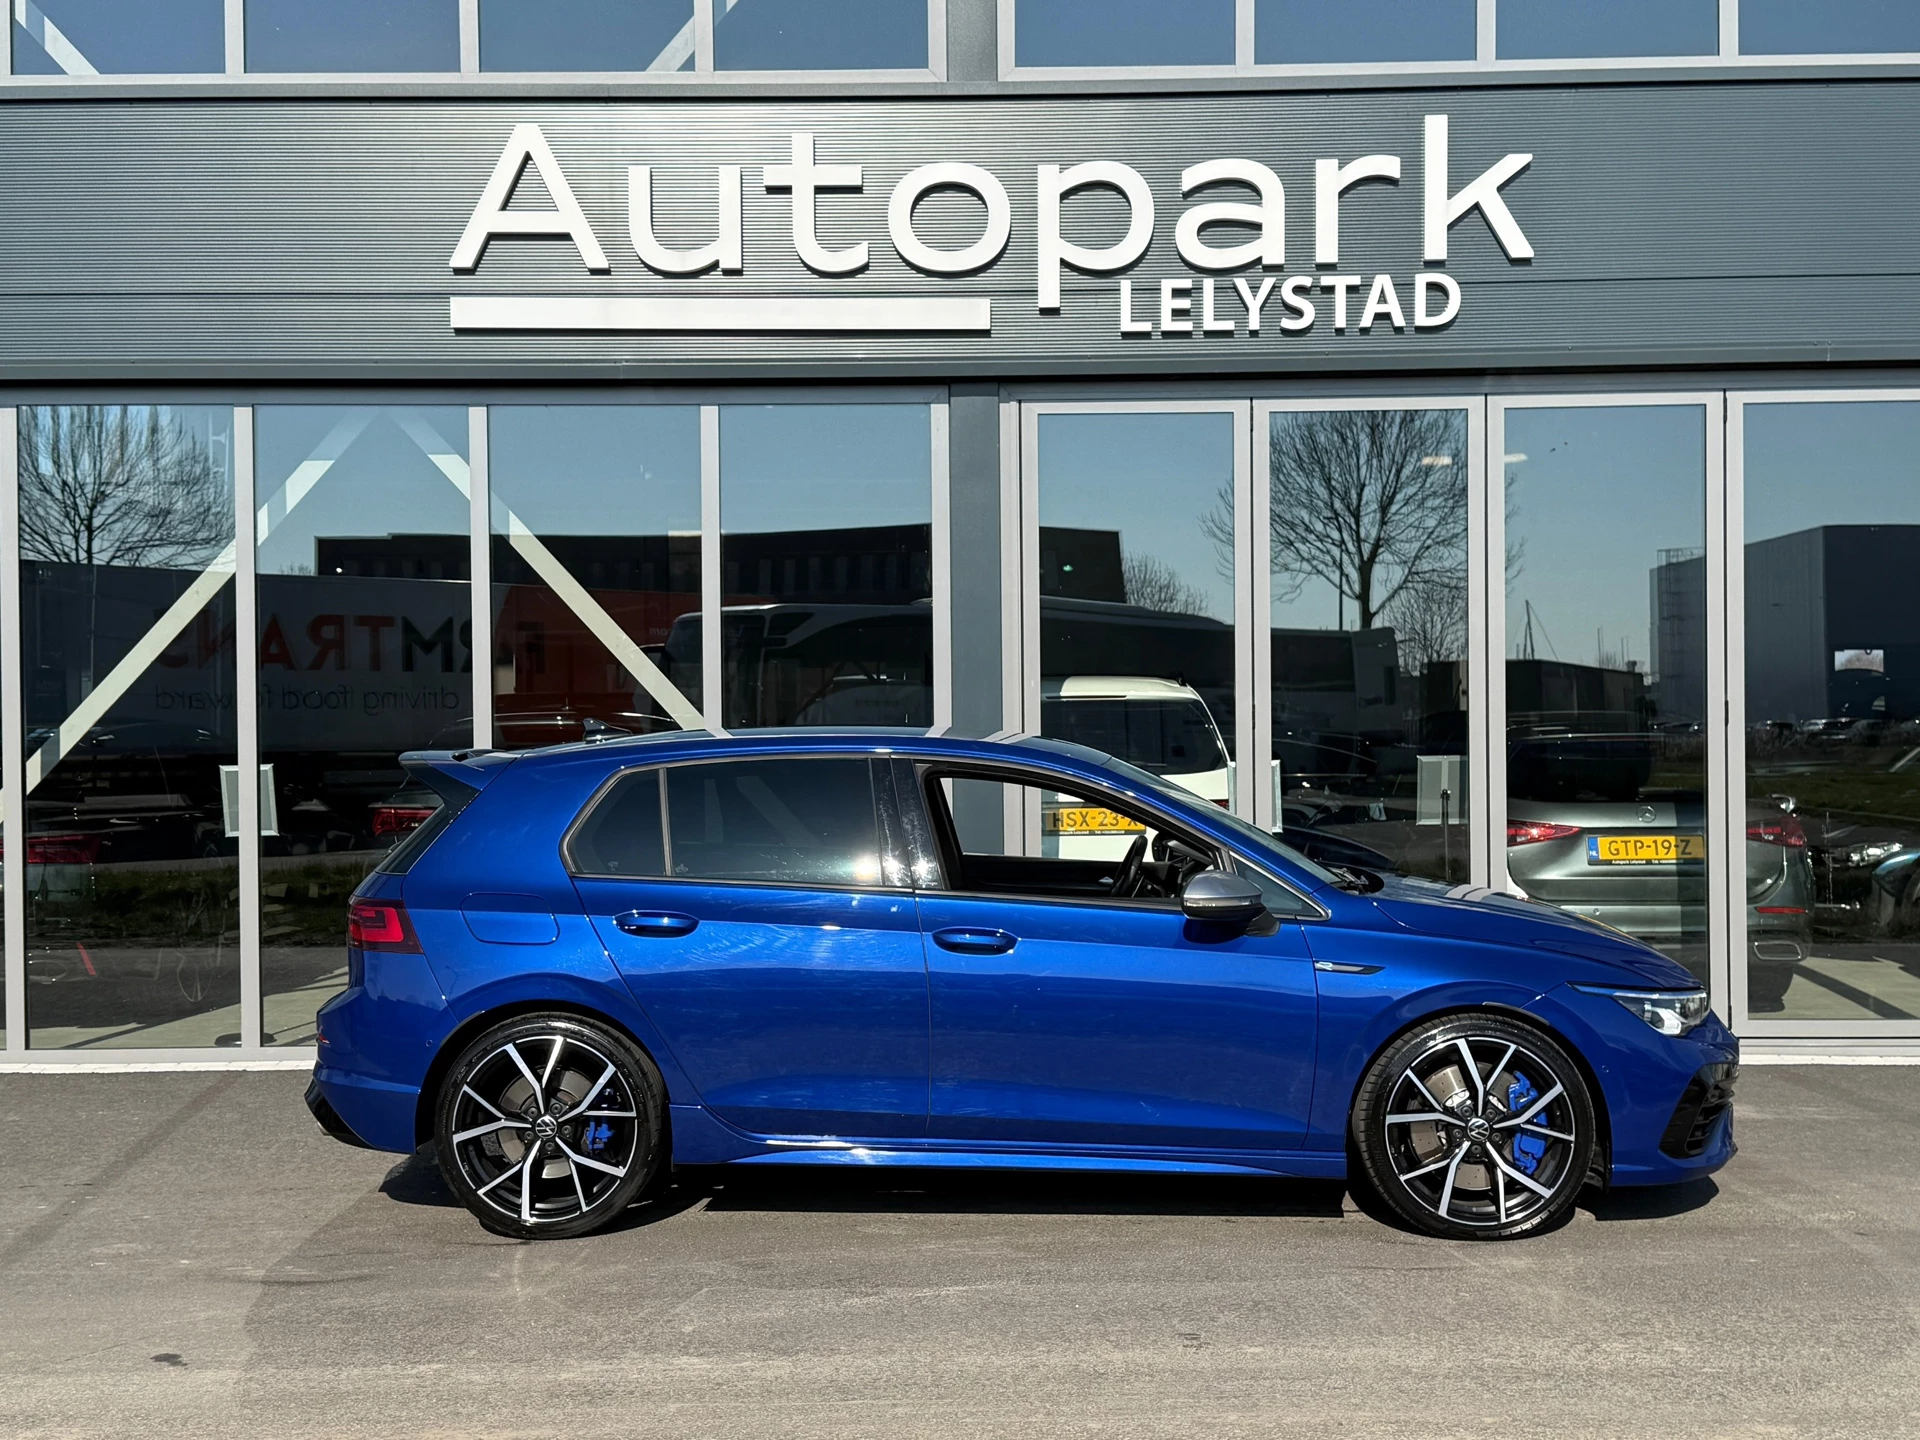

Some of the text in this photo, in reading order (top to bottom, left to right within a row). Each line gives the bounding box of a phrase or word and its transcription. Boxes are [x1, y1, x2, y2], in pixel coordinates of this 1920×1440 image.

[449, 114, 1534, 311] Autopark
[1120, 273, 1462, 335] LELYSTAD
[1589, 849, 1598, 857] NL
[1607, 839, 1693, 856] GTP-19-Z
